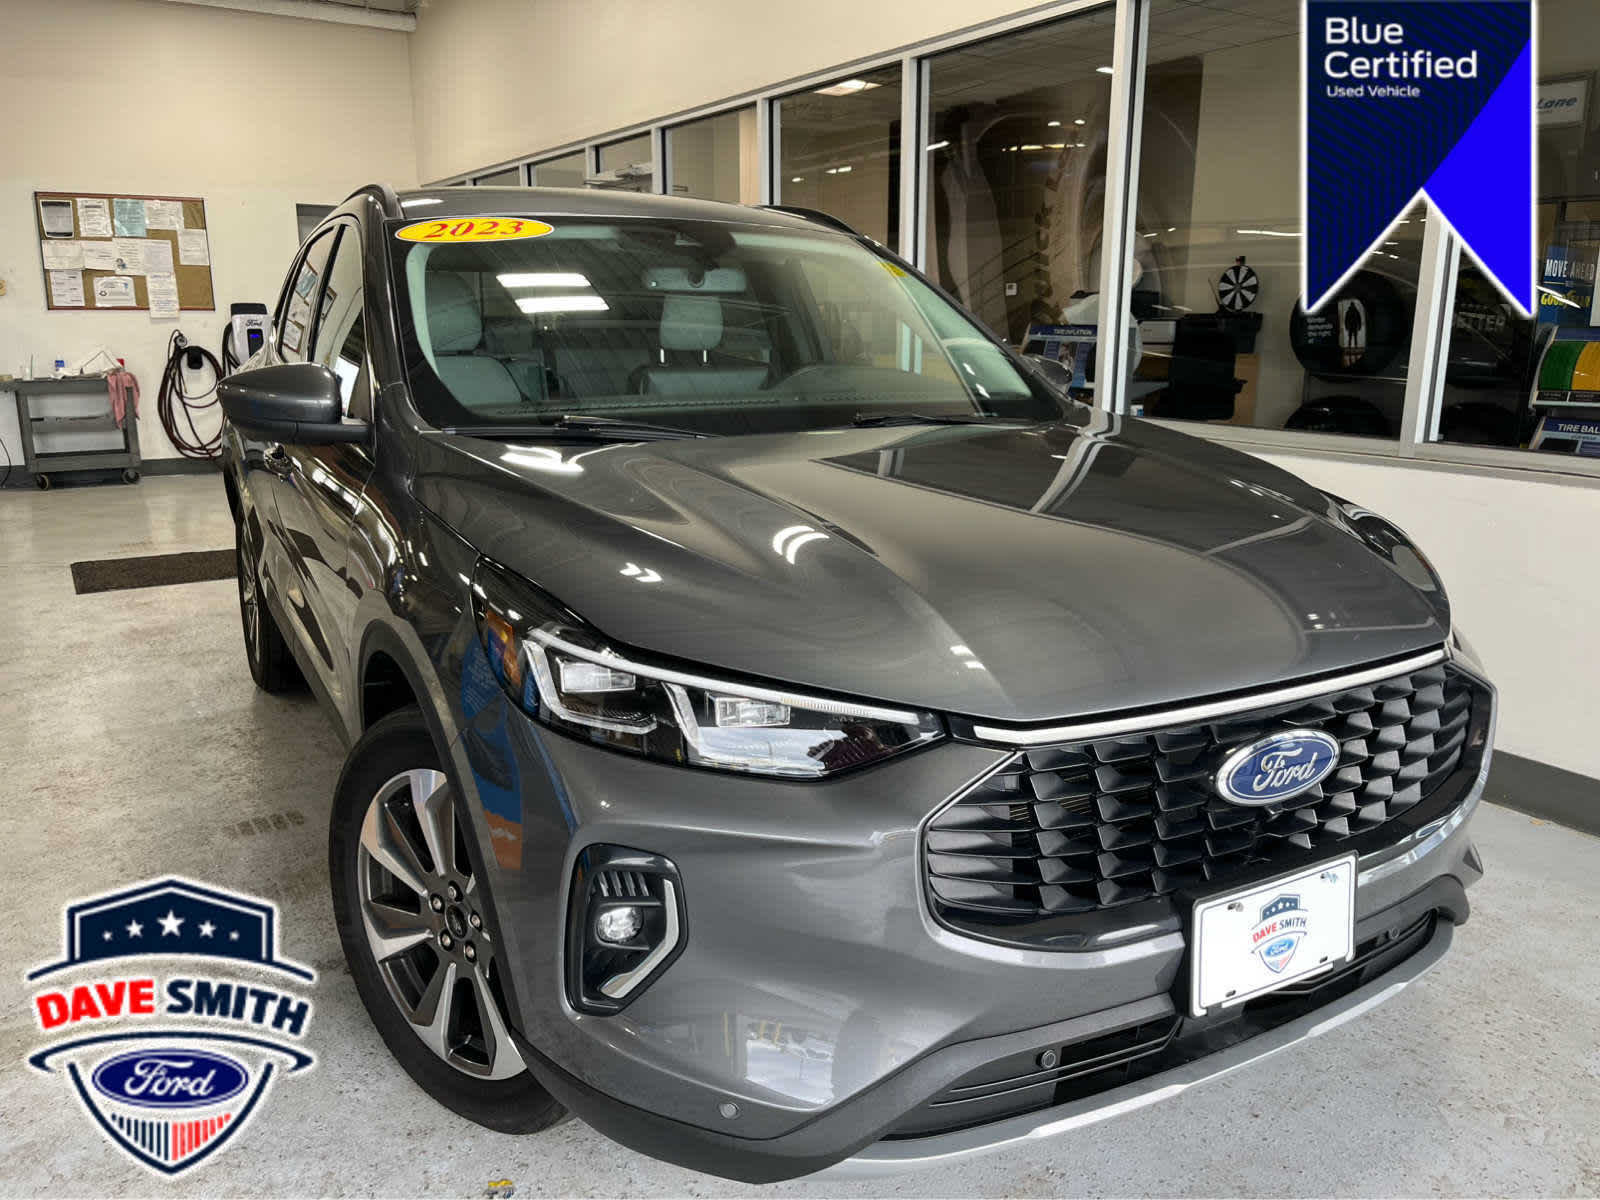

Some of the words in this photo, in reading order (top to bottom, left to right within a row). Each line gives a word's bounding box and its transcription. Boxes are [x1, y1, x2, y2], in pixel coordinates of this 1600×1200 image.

[424, 220, 525, 239] 2023
[1544, 258, 1569, 278] MOVE
[1558, 423, 1580, 433] TIRE
[1252, 747, 1318, 792] Ford
[1252, 921, 1278, 943] DAVE
[1279, 917, 1308, 931] SMITH
